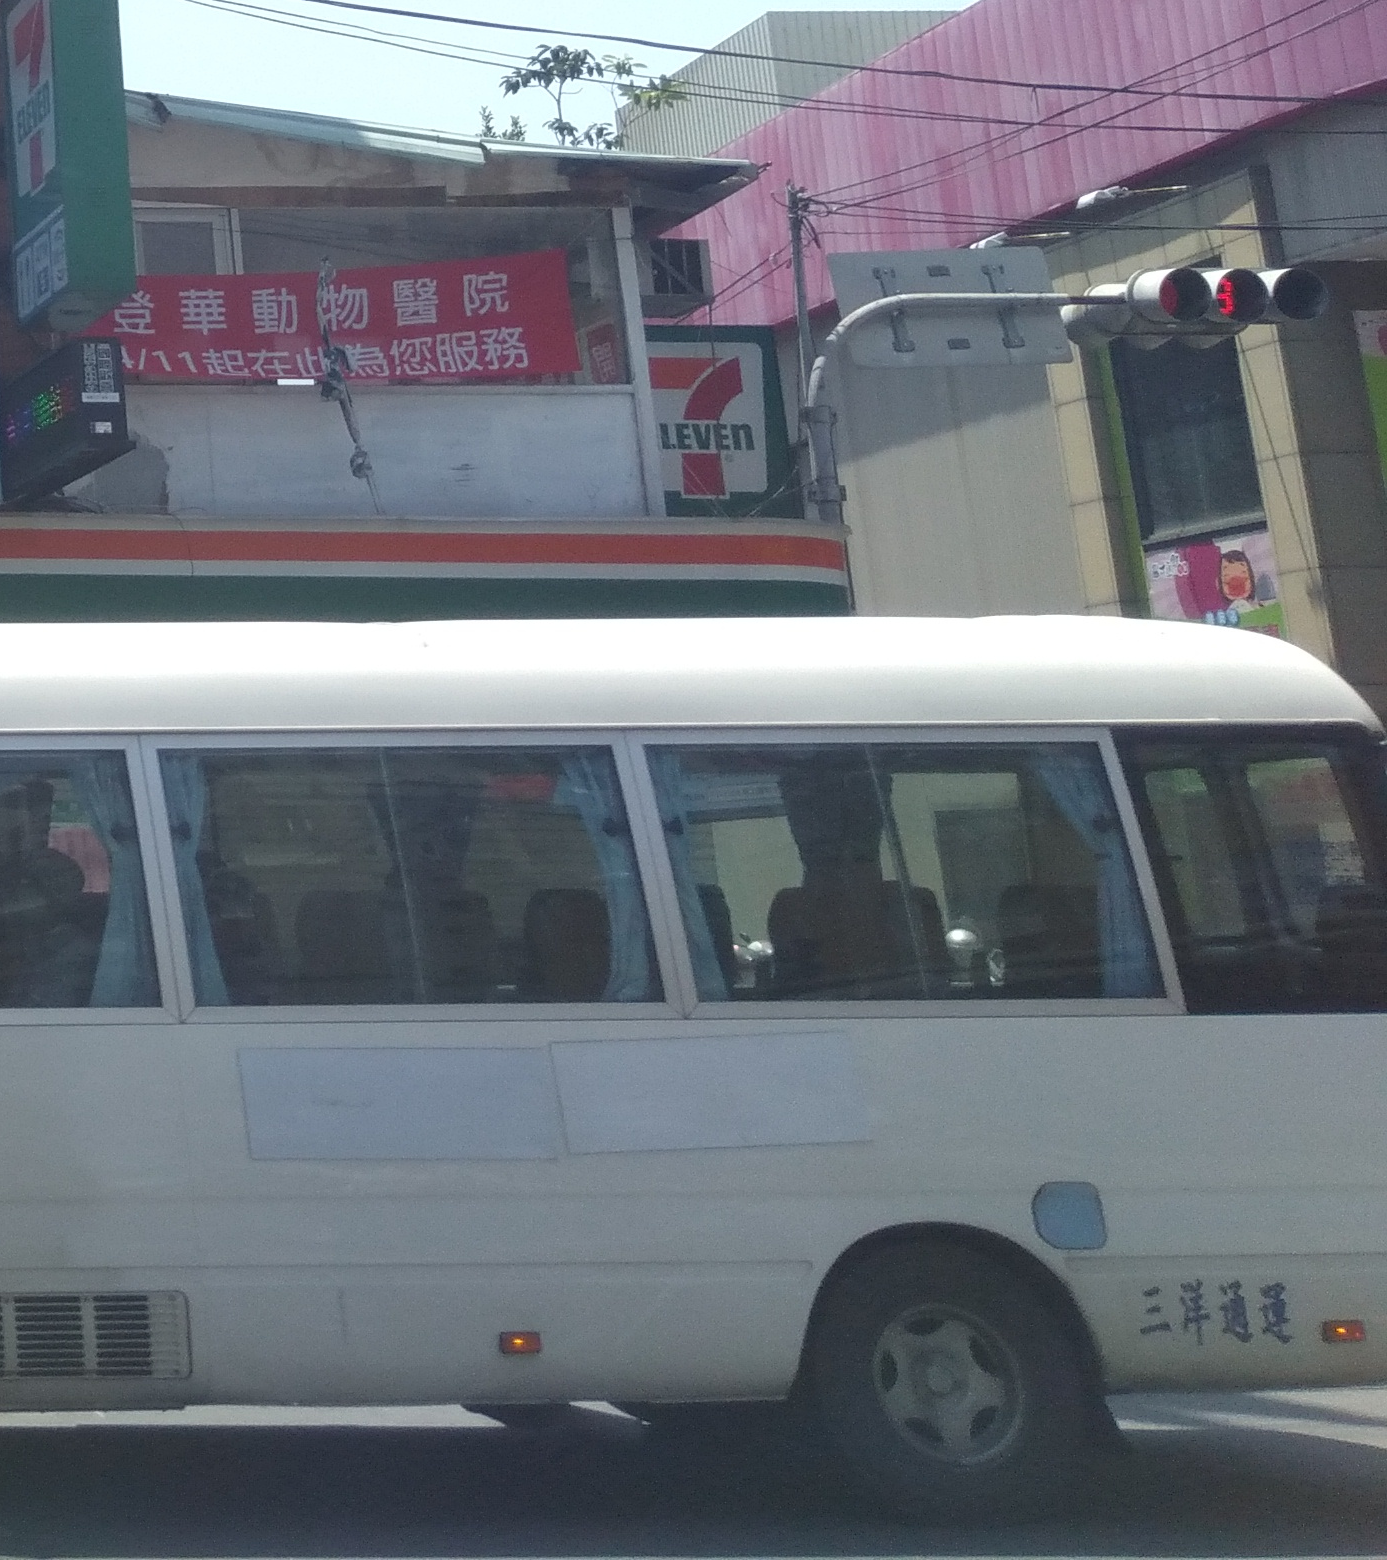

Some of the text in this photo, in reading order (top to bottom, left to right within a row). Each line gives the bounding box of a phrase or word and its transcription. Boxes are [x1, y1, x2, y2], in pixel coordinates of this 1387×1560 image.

[112, 271, 509, 336] 登華動物醫院
